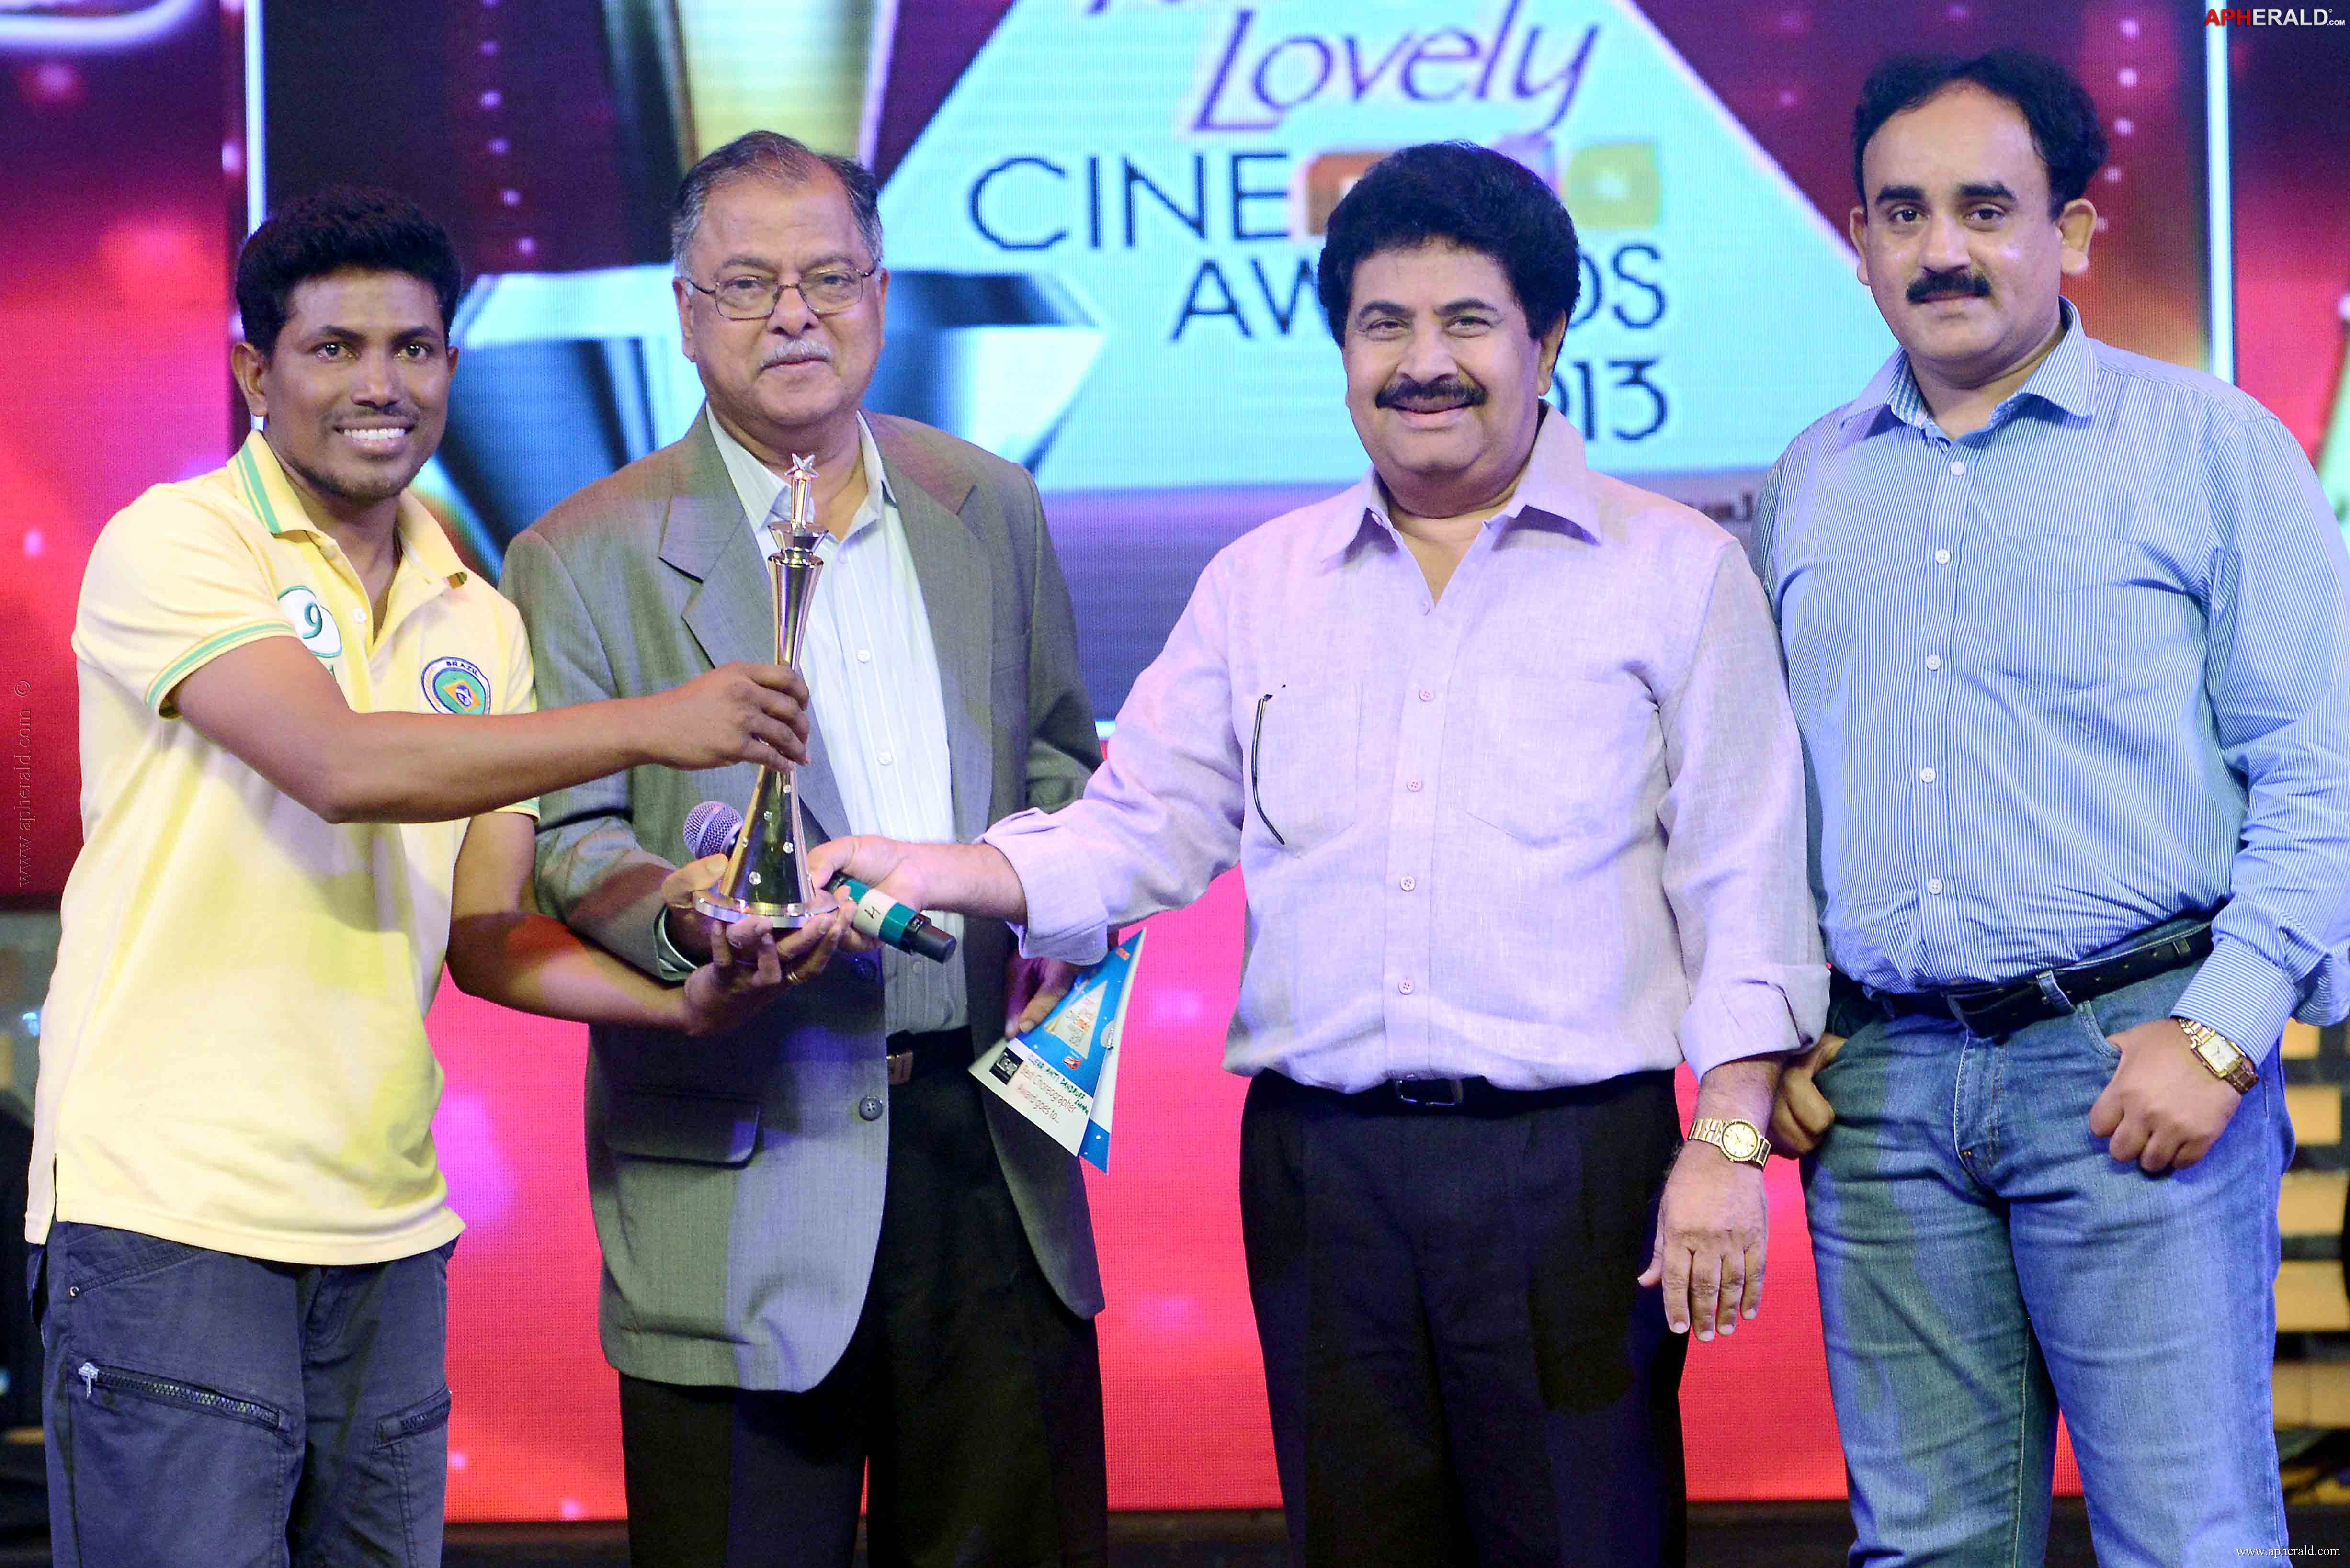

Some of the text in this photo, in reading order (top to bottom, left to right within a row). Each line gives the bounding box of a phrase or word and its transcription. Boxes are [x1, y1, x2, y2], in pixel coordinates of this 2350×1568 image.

[1190, 0, 1602, 140] Lovely
[303, 602, 323, 639] 9
[446, 661, 479, 677] BRAZIL
